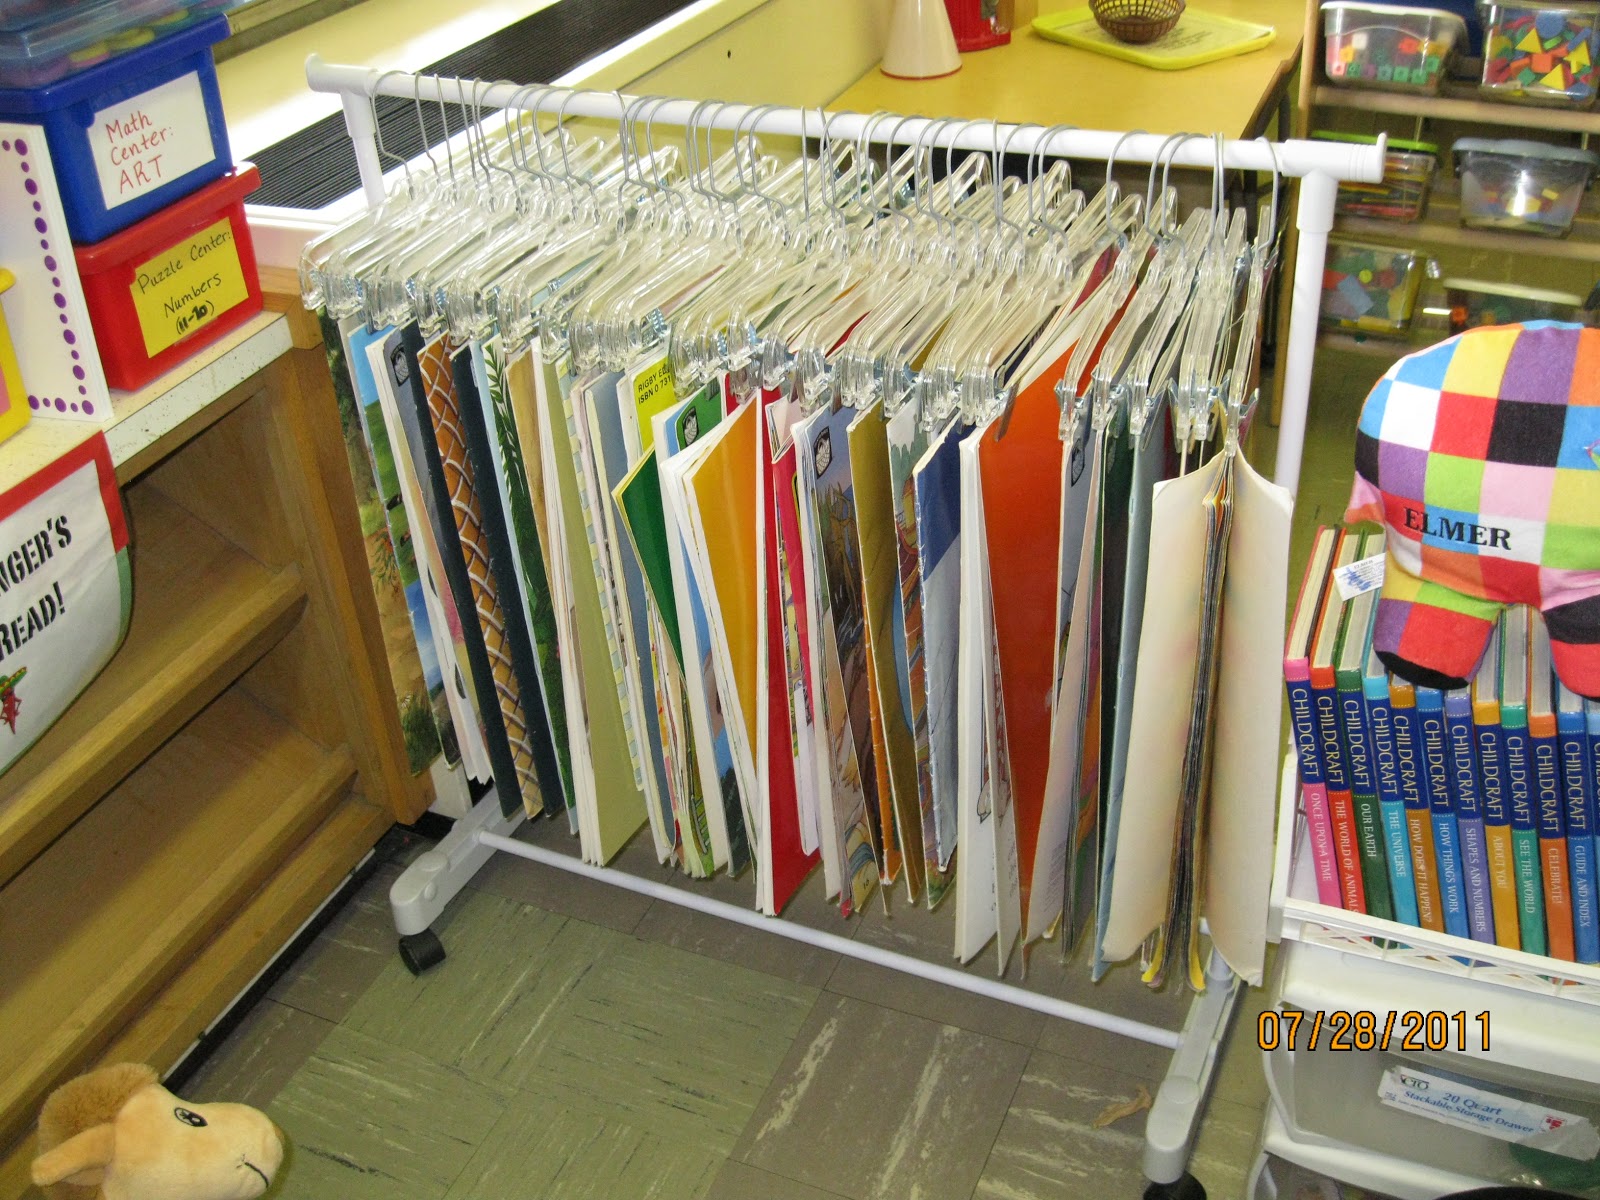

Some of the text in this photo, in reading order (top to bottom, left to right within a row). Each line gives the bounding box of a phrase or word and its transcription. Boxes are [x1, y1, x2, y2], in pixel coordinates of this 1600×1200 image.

[105, 110, 152, 143] Math
[111, 126, 174, 166] Center:
[120, 154, 162, 194] ART
[137, 231, 231, 294] Puzzle Center:
[163, 273, 221, 318] Numbers
[638, 373, 657, 393] RIGBY
[638, 389, 654, 405] ISBN
[655, 384, 659, 393] 0
[1403, 506, 1511, 550] ELMER
[0, 581, 66, 663] READ!
[1292, 688, 1320, 777] CHILDCRAFT
[1317, 696, 1344, 784] CHILDCRAFT
[1344, 700, 1370, 787] CHILDCRAFT
[1372, 707, 1398, 795] CHILDCRAFT
[1394, 715, 1419, 803] CHILDCRAFT
[1424, 720, 1449, 807] CHILDCRAFT
[1451, 725, 1476, 812] CHILDCRAFT
[1480, 732, 1503, 820] CHILDCRAFT
[1507, 736, 1530, 824] CHILDCRAFT
[1536, 744, 1559, 832] CHILDCRAFT
[1564, 742, 1587, 830] CHILDCRAFT
[1311, 792, 1324, 819] ONCE
[1315, 822, 1328, 850] UPON
[1335, 800, 1347, 819] THE
[1361, 803, 1377, 857] OUR EARTH
[1338, 821, 1352, 856] WORLD
[1343, 858, 1354, 870] OF
[1389, 810, 1406, 877] THE UNIVERSE
[1439, 823, 1459, 913] HOW THINGS WORK
[1493, 835, 1508, 889] ABOUT YOU
[1320, 860, 1332, 881] TIME
[1410, 819, 1432, 923] HOW DOES IT HAPPEN?
[1466, 828, 1487, 932] SHAPES AND NUMBERS
[1520, 839, 1536, 913] SEE THE WORLD
[1548, 848, 1563, 904] CELEBRATE!
[1575, 845, 1591, 927] GUIDE AND INDEX
[1404, 1090, 1451, 1111] Stackable
[1453, 1105, 1493, 1123] Storage
[1494, 1117, 1534, 1133] Drawer
[1442, 1092, 1461, 1105] 20
